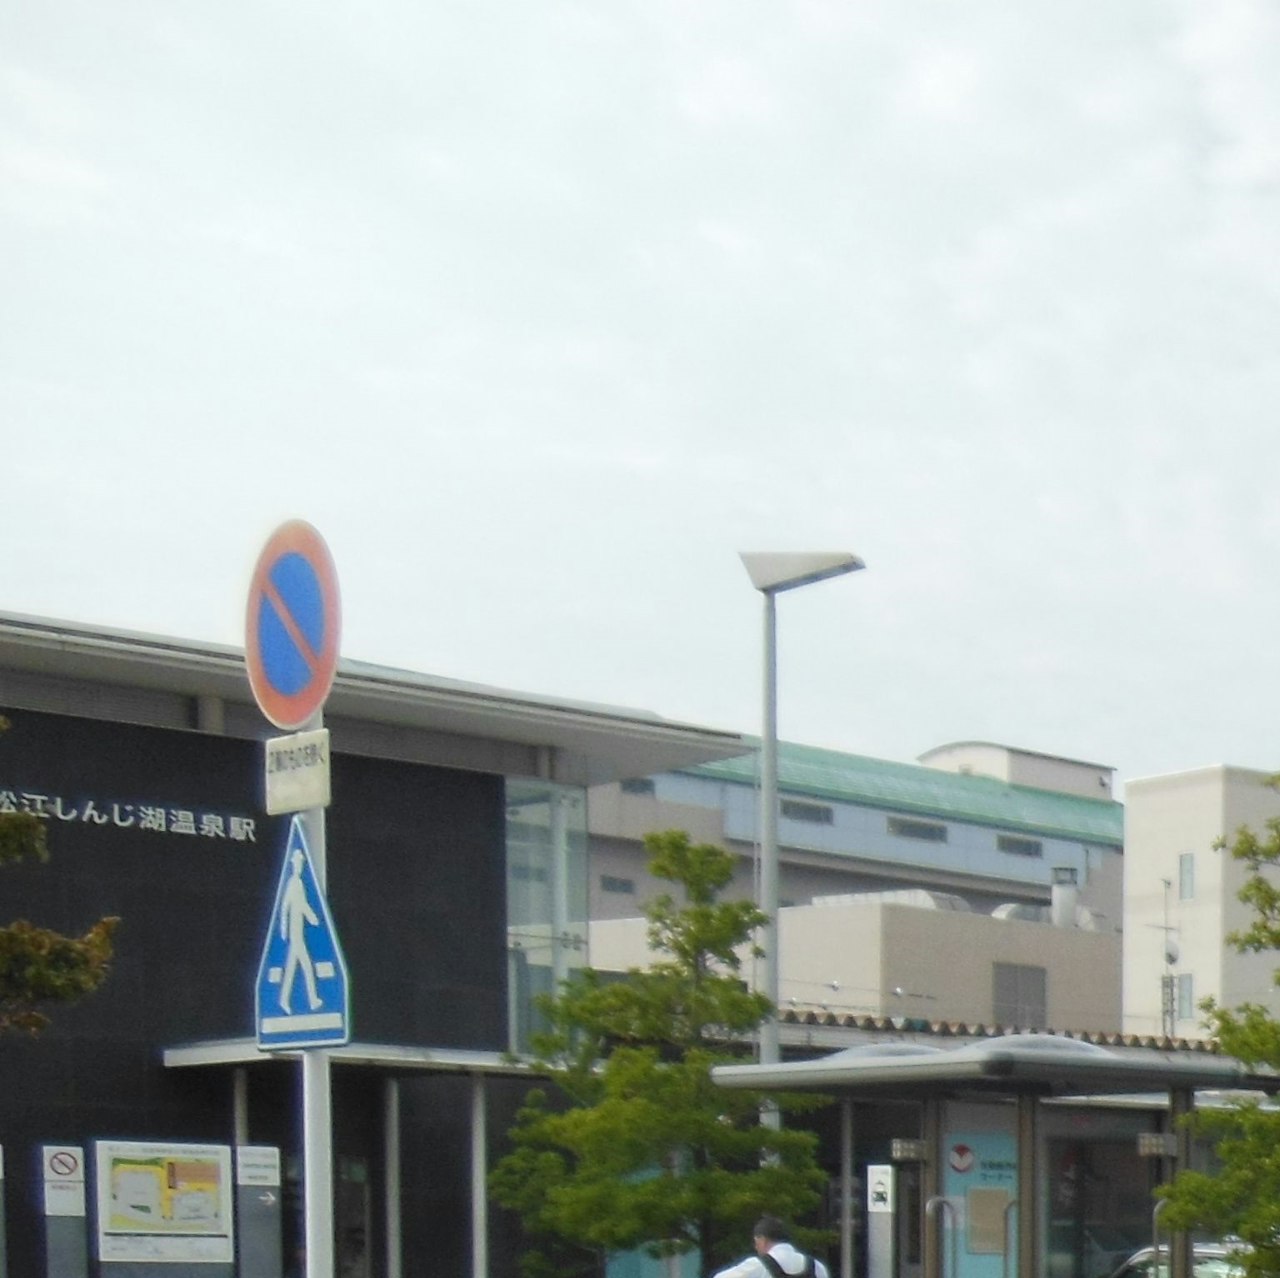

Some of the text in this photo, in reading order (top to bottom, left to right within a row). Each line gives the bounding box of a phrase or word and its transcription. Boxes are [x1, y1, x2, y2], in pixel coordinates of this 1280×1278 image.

[0, 790, 257, 843] 松江しんじ湖温泉駅
